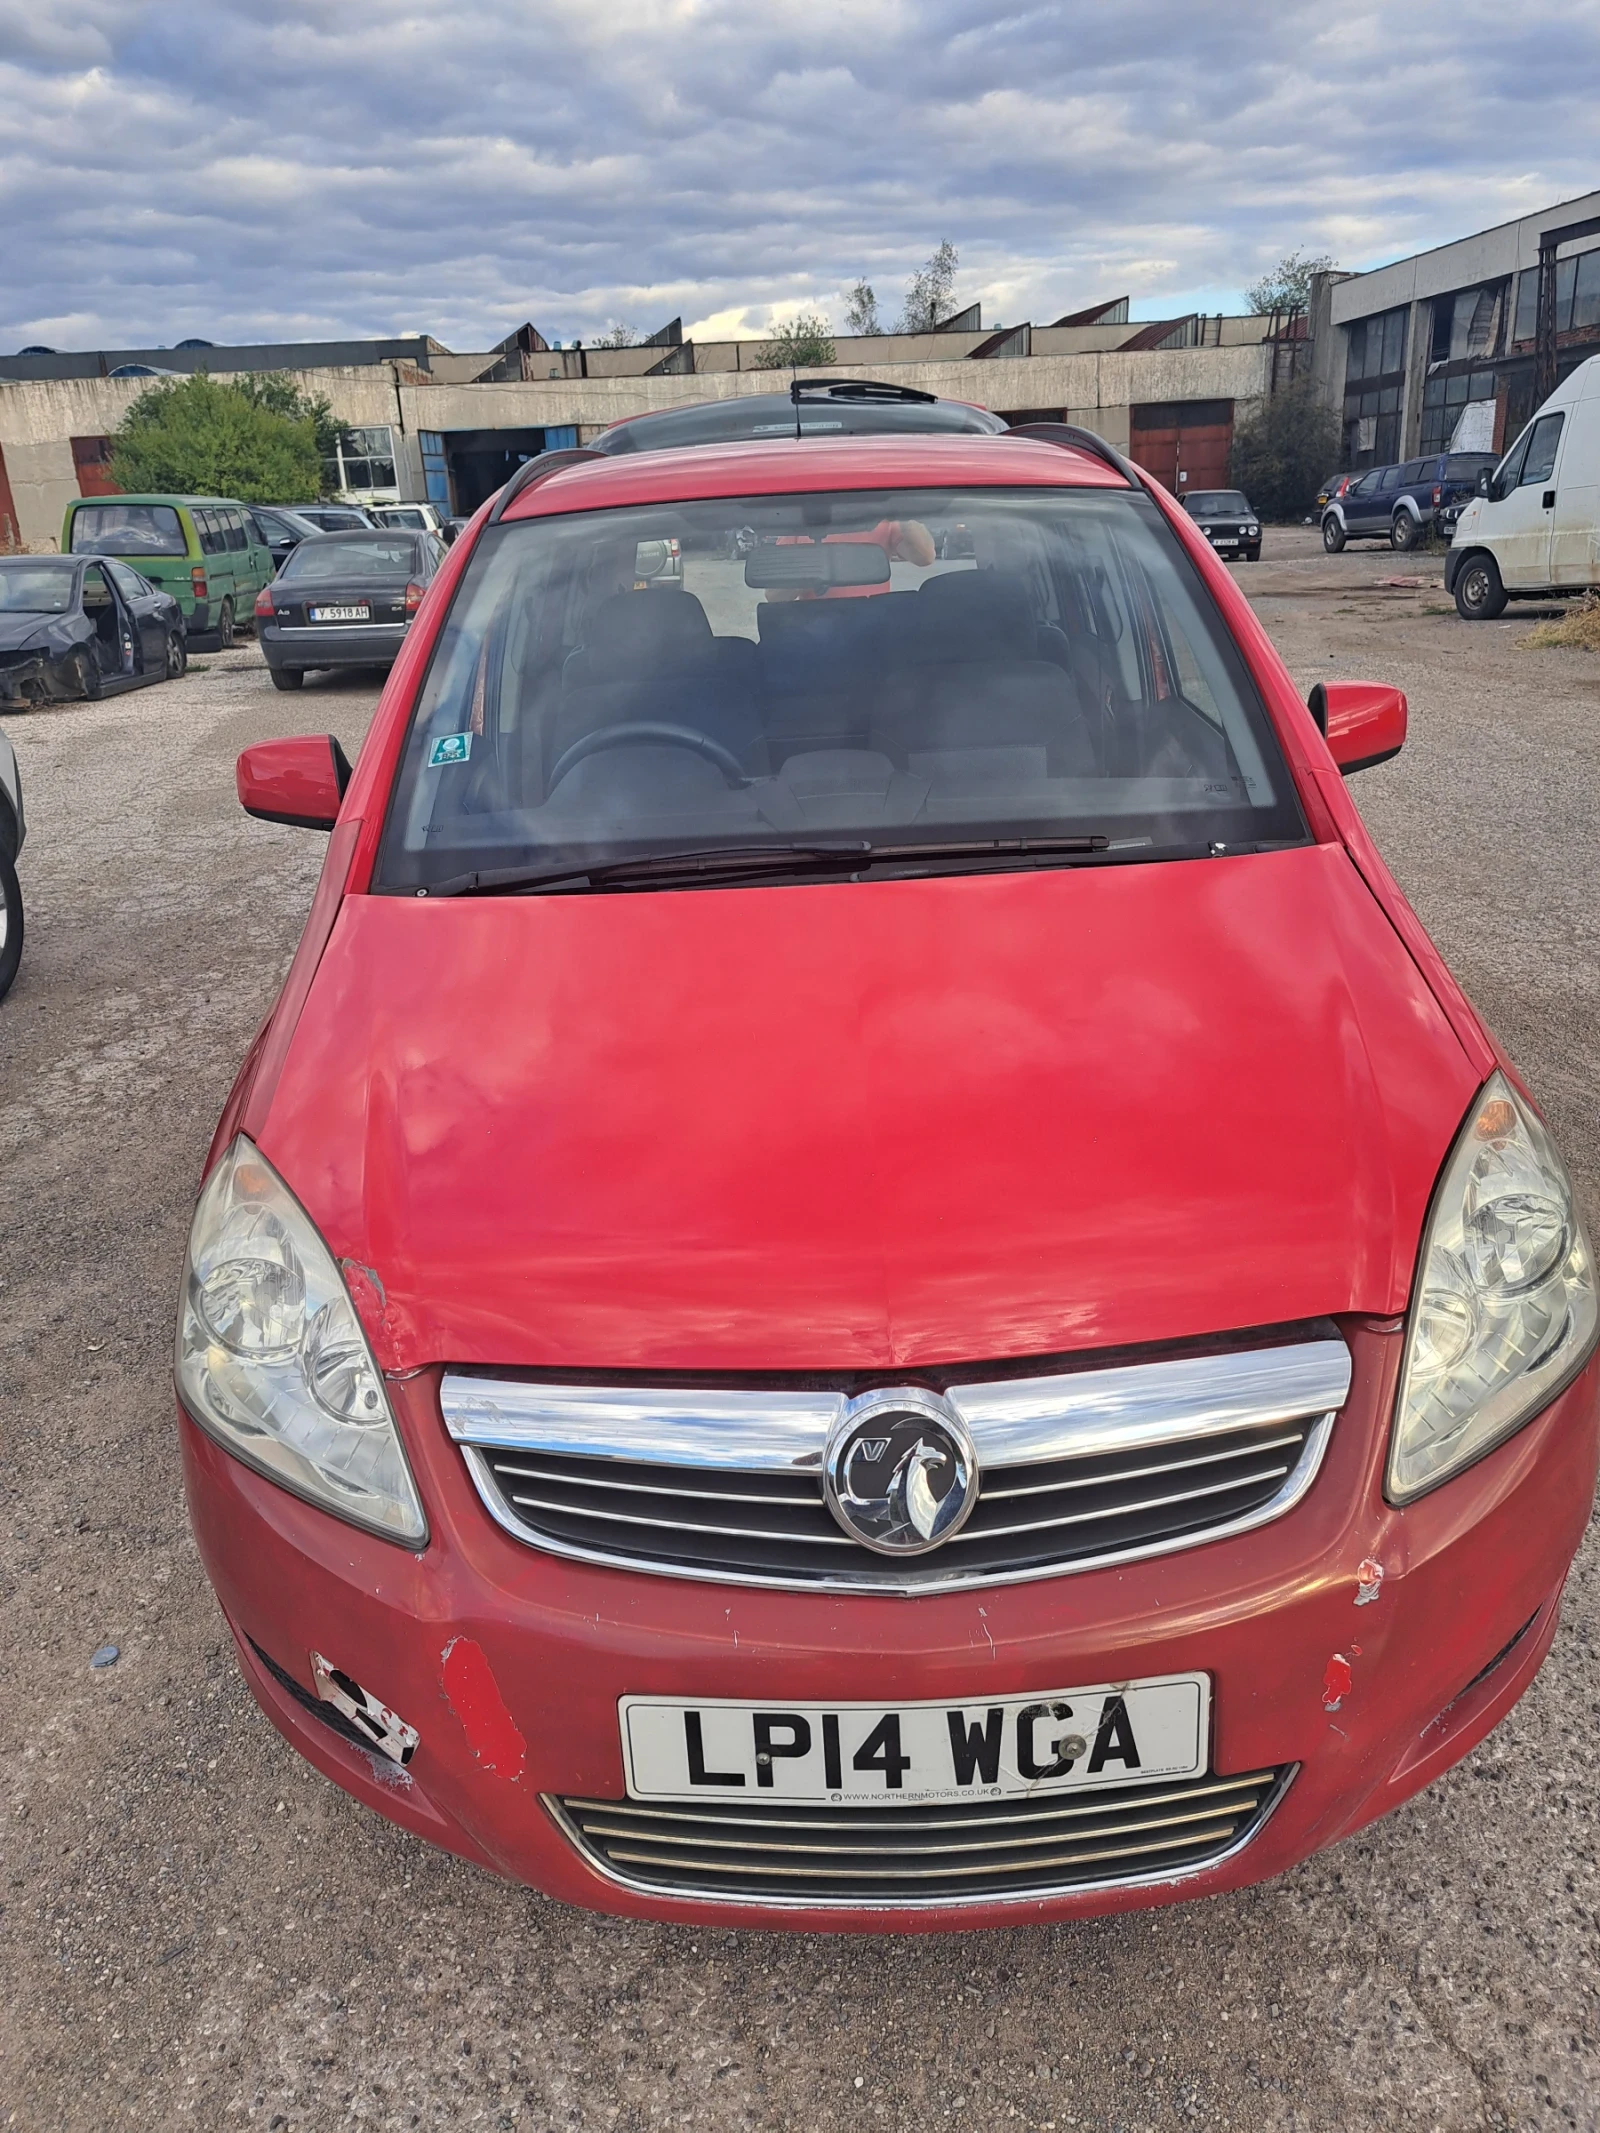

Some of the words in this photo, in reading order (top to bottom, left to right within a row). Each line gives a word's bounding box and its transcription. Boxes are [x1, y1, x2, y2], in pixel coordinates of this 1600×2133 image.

[330, 608, 353, 618] 5918
[355, 607, 368, 617] AH
[684, 1711, 910, 1789] LP14
[947, 1695, 1141, 1785] WGA
[844, 1788, 990, 1801] WWW.NORTHERNMOTORS.CO.UK
